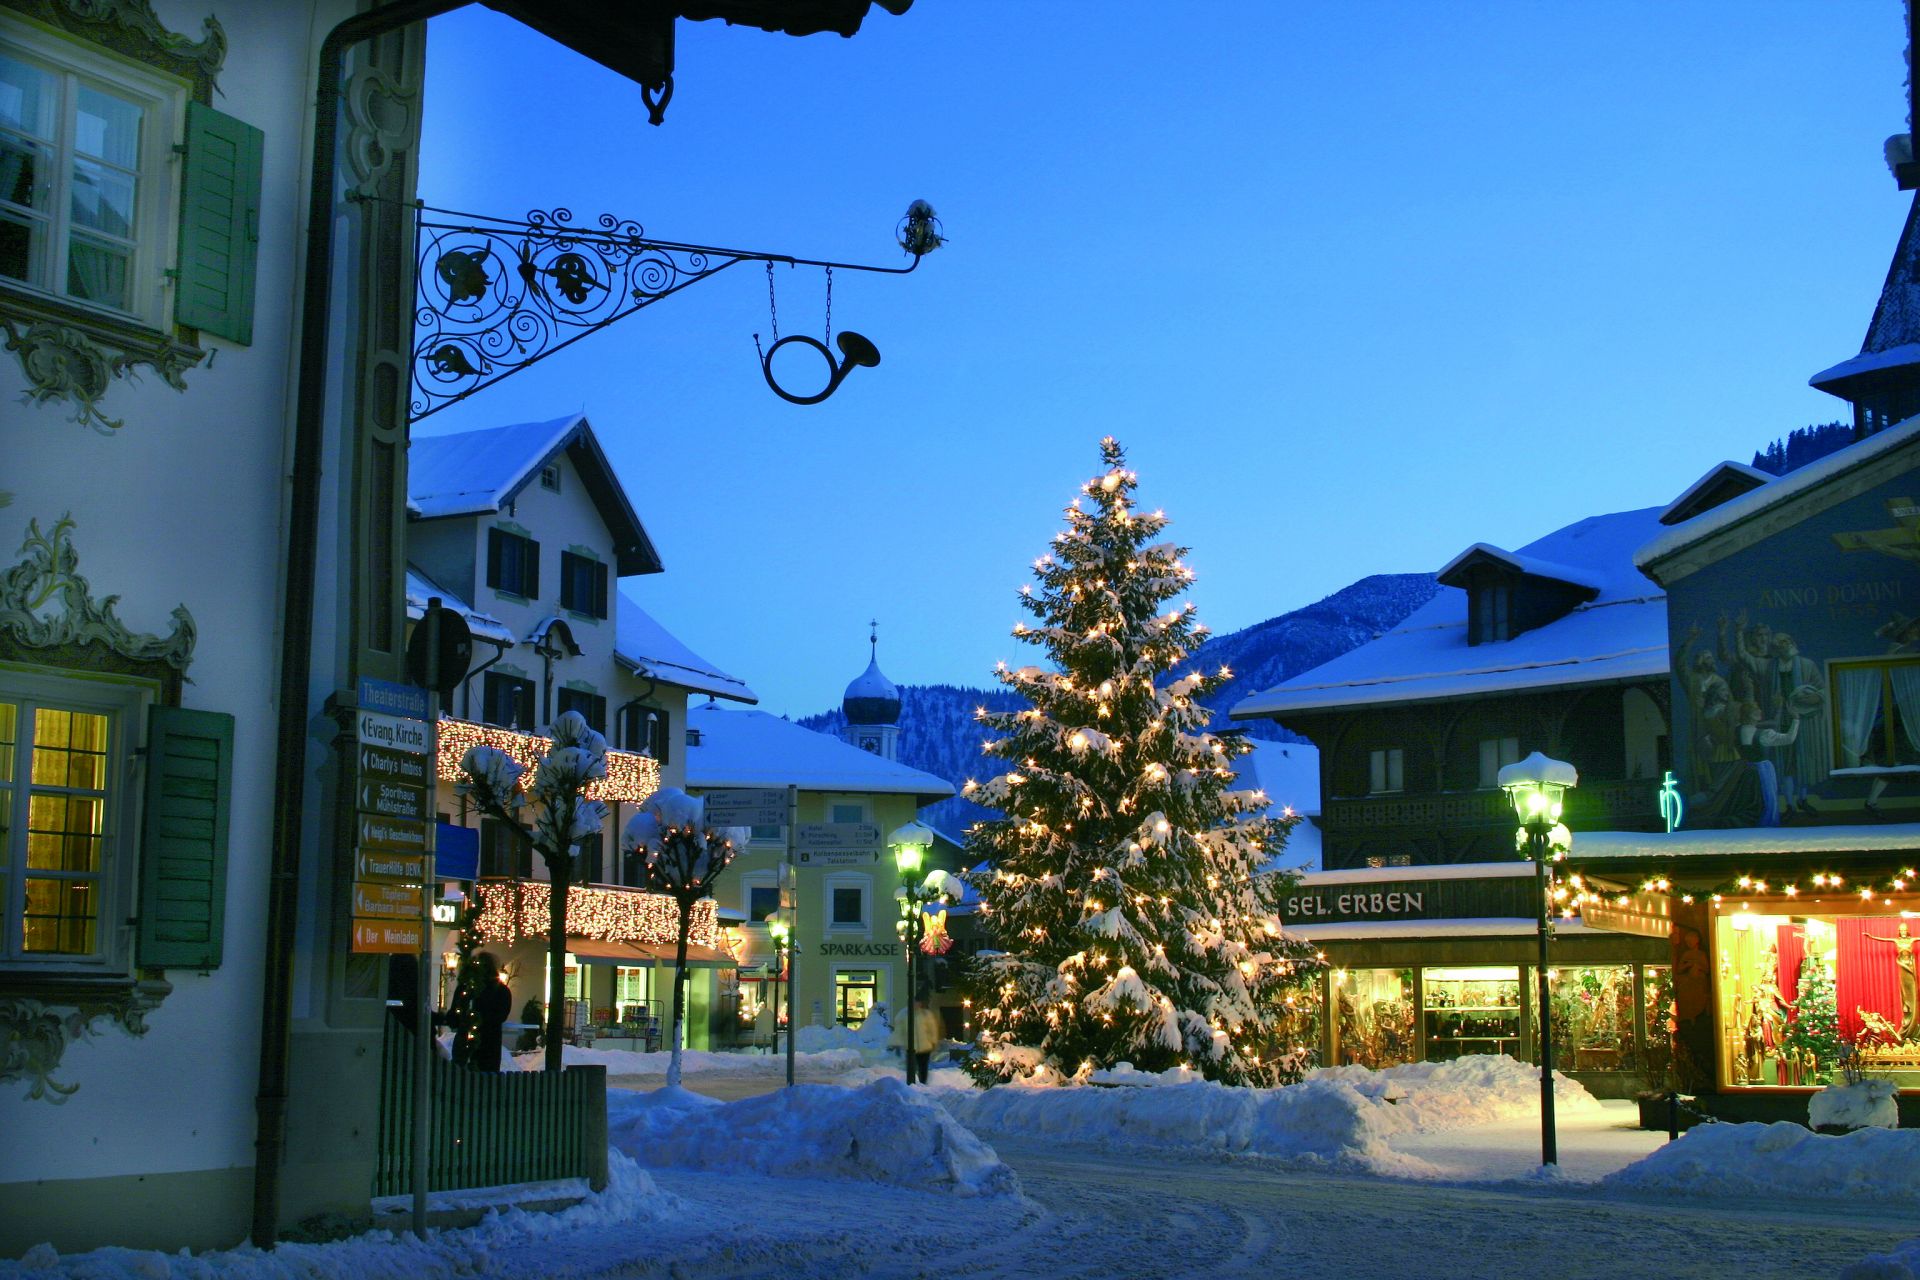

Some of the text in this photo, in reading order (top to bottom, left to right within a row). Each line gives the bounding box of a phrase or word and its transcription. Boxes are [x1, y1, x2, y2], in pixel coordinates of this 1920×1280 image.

[1759, 580, 1902, 609] ANNO DOMINI
[363, 682, 425, 712] Theaterstraße
[397, 722, 423, 746] Kirche
[371, 752, 423, 777] Charly's Imbiss
[380, 784, 416, 801] Sporthaus
[364, 898, 394, 913] Barbara
[1288, 892, 1423, 916] SEL. ERBEN
[366, 928, 419, 945] Der Weinladen
[820, 943, 899, 956] SPARKASSE
